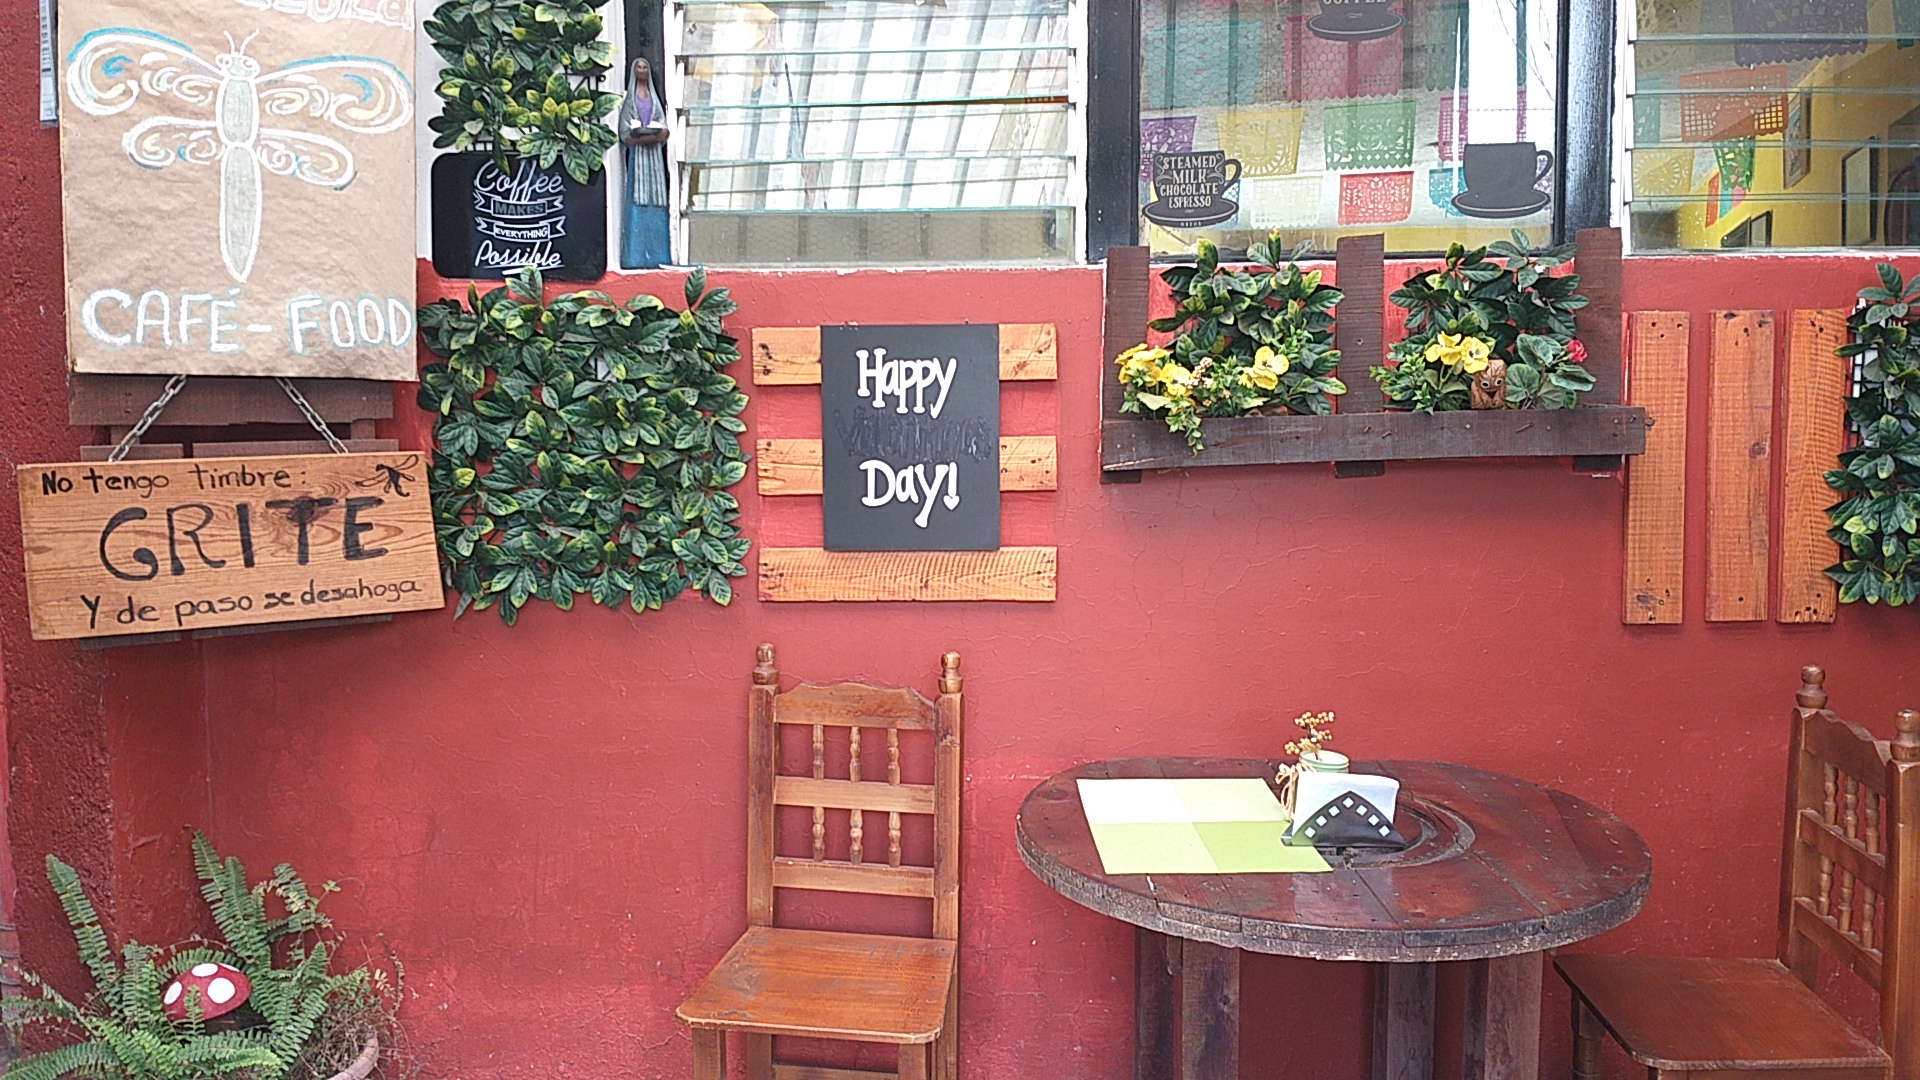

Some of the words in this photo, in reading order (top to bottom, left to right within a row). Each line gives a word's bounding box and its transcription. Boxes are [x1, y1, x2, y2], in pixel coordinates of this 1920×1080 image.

[1163, 155, 1217, 169] STEAMED
[1172, 169, 1207, 184] MILK
[475, 159, 564, 203] Coffee
[1160, 183, 1218, 196] CHOCOLATE
[495, 202, 544, 216] MAKES
[1169, 196, 1212, 208] ESPRESSO
[495, 227, 548, 238] EVERYTHING
[475, 240, 562, 267] Possible
[287, 294, 413, 354] FOOD
[855, 348, 957, 419] Happy
[42, 470, 73, 495] No
[83, 467, 170, 498] tengo
[187, 464, 307, 489] timbre:
[859, 460, 960, 528] Day!
[100, 496, 390, 581] GRITE
[80, 594, 101, 629] Y
[117, 600, 160, 624] de
[175, 596, 254, 627] paso
[264, 591, 295, 609] se
[301, 578, 422, 605] desahoga
